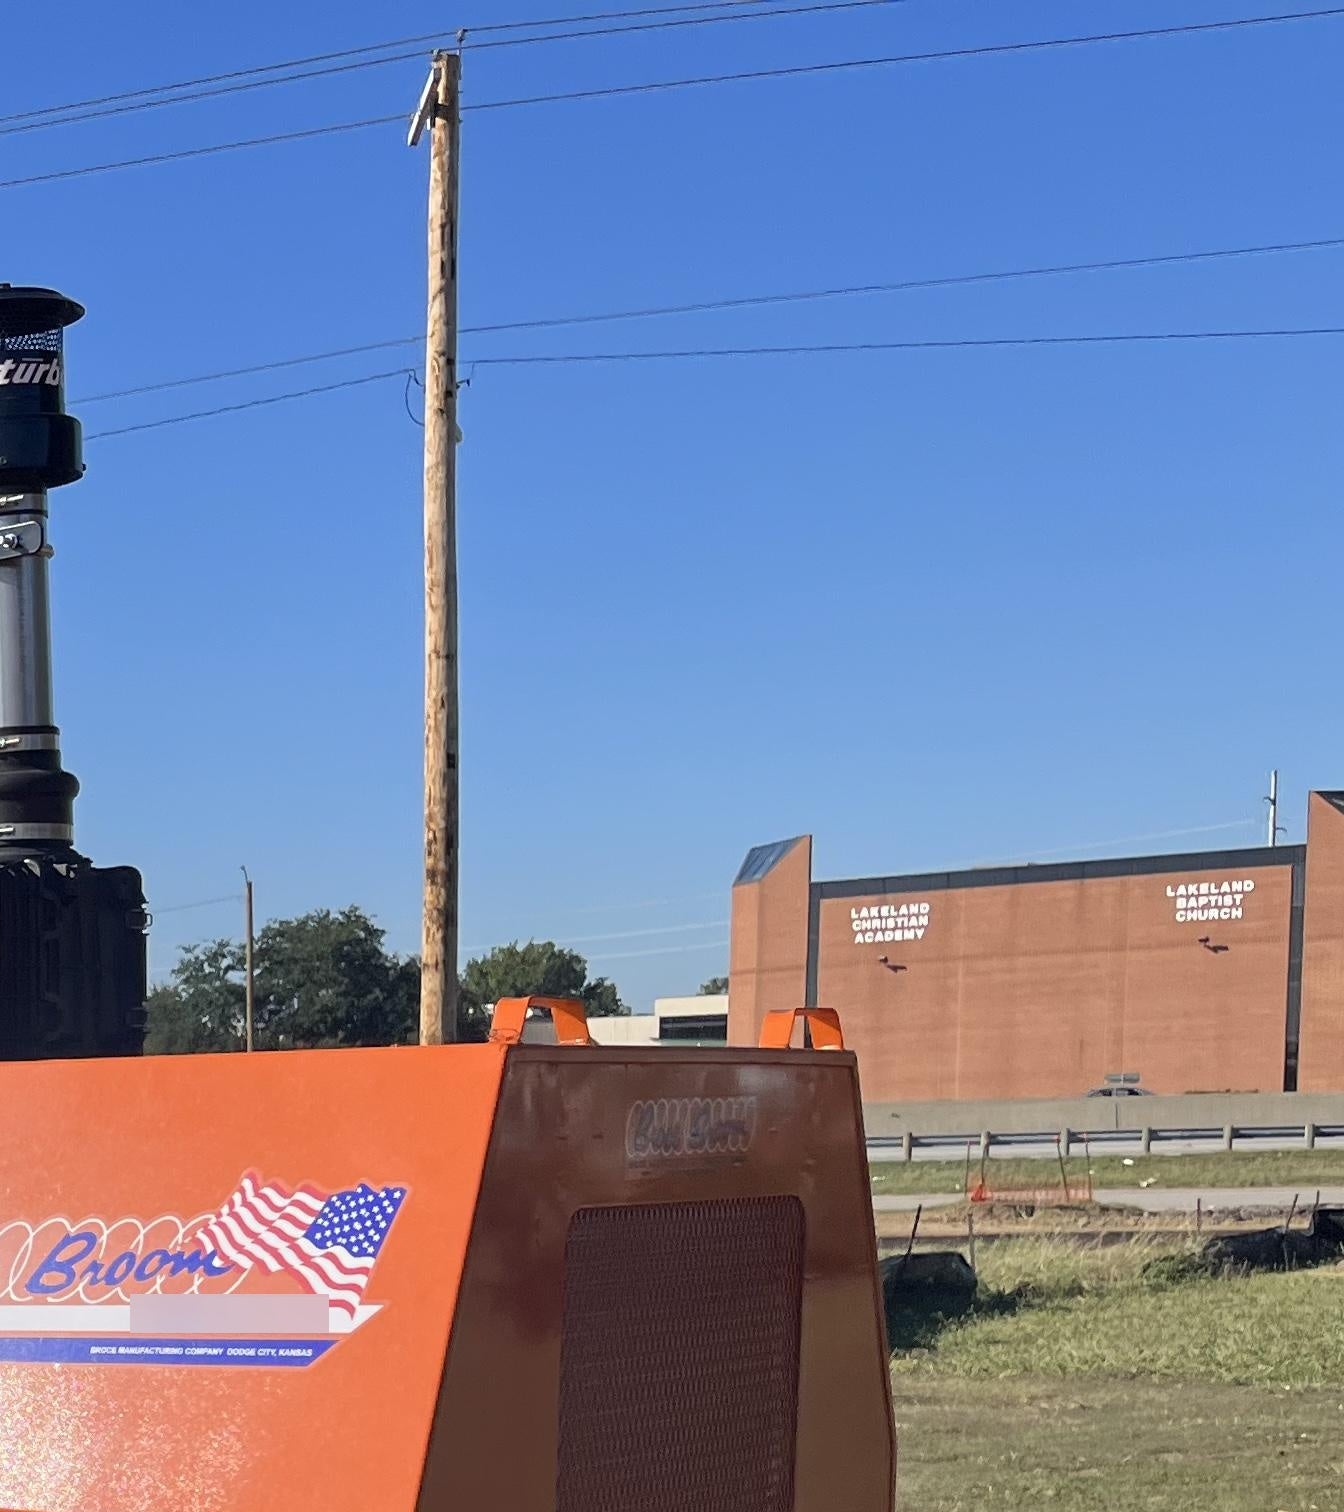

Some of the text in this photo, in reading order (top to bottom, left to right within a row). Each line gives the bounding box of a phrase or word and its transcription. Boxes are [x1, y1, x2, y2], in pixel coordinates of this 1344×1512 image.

[1166, 880, 1255, 897] LAKELAND
[1176, 894, 1244, 909] BAPTIST
[850, 903, 930, 919] LAKELAND
[1175, 907, 1243, 922] CHURCH
[852, 915, 929, 931] CHRISTIAN
[855, 928, 925, 944] ACADEMY
[25, 1230, 228, 1296] Broom
[90, 1346, 117, 1355] BROCE
[118, 1346, 183, 1355] MANUFACTURING
[184, 1347, 224, 1356] COMPANY
[226, 1348, 256, 1356] DODGE
[257, 1348, 277, 1357] CITY,
[278, 1348, 313, 1357] KANSAS
